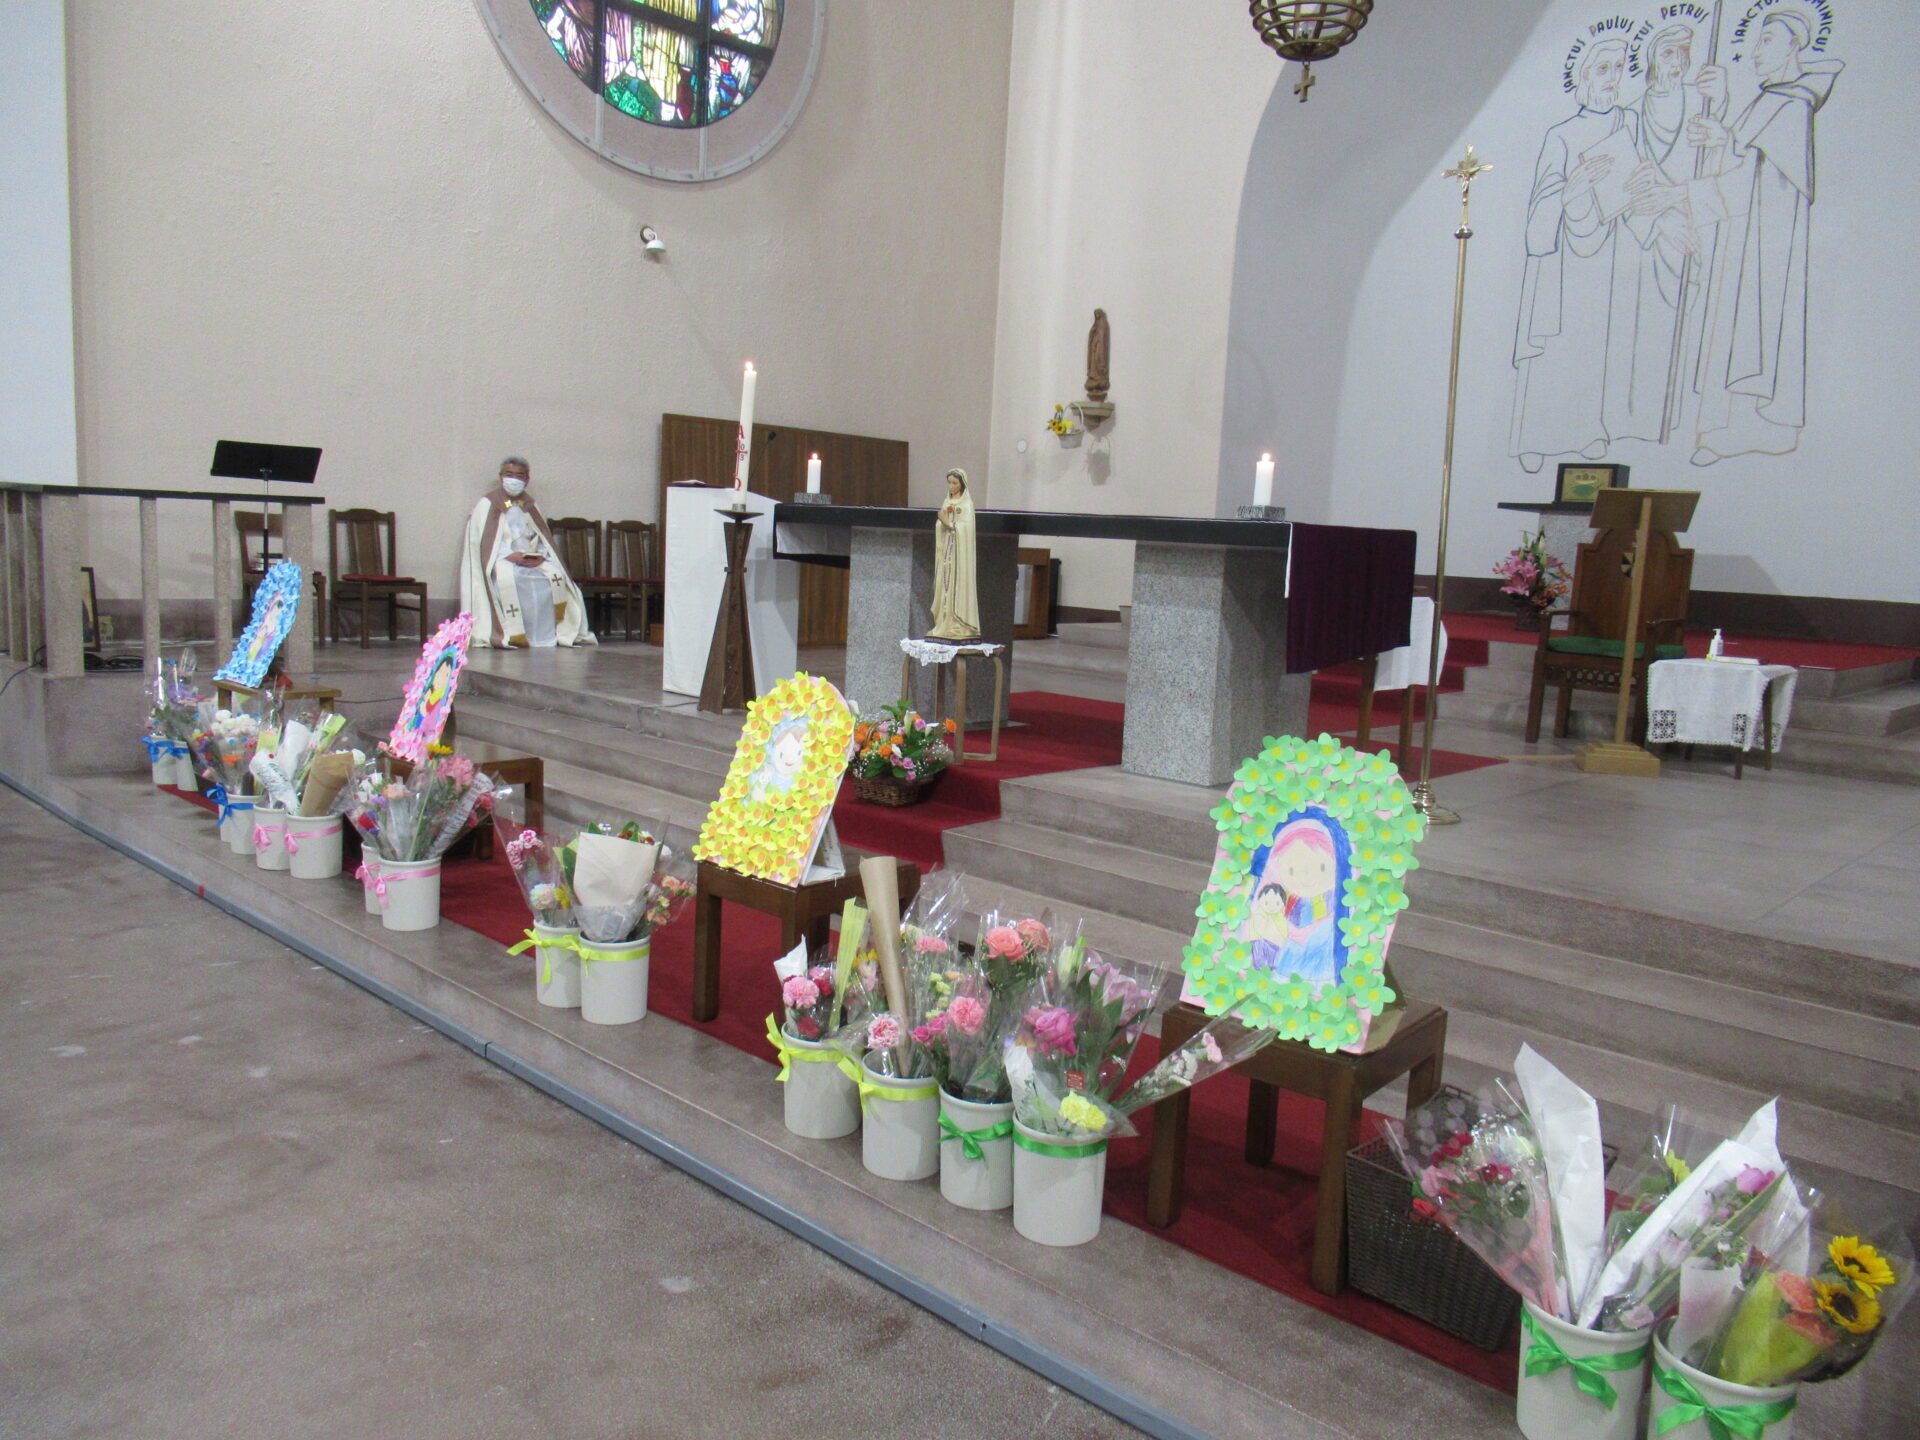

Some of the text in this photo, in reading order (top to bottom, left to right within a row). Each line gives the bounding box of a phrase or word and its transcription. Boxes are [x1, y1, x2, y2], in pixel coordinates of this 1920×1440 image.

[1563, 15, 1635, 93] SANCTUS PAULUS
[1628, 3, 1710, 78] SANCTUS PETRUS
[1731, 0, 1779, 44] SANCTU
